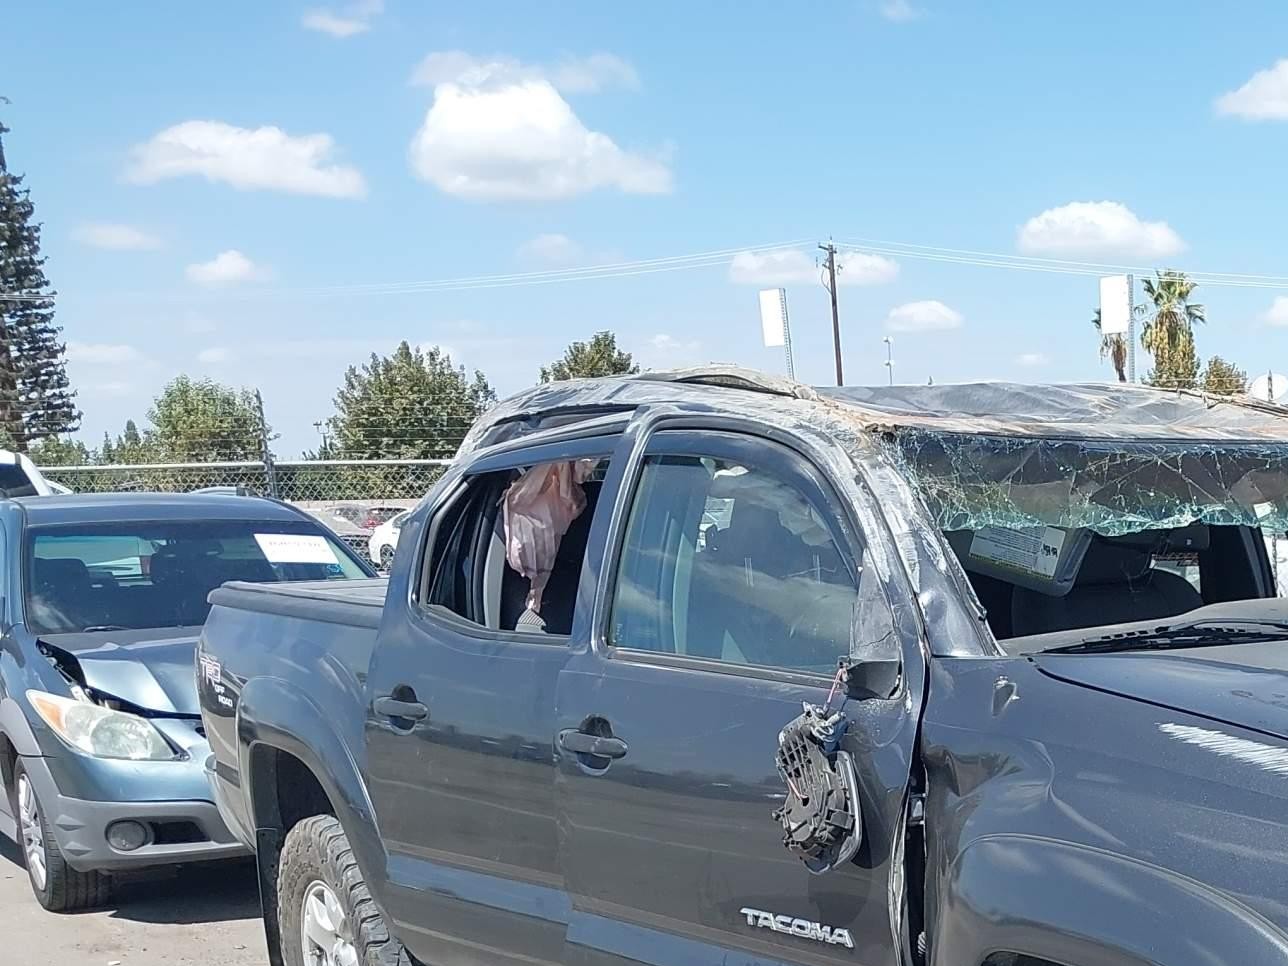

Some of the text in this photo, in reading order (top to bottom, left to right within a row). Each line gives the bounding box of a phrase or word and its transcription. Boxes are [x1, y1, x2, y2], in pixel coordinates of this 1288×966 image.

[214, 684, 225, 694] OFF
[218, 695, 233, 707] ROAD
[739, 907, 855, 949] TACOMA
